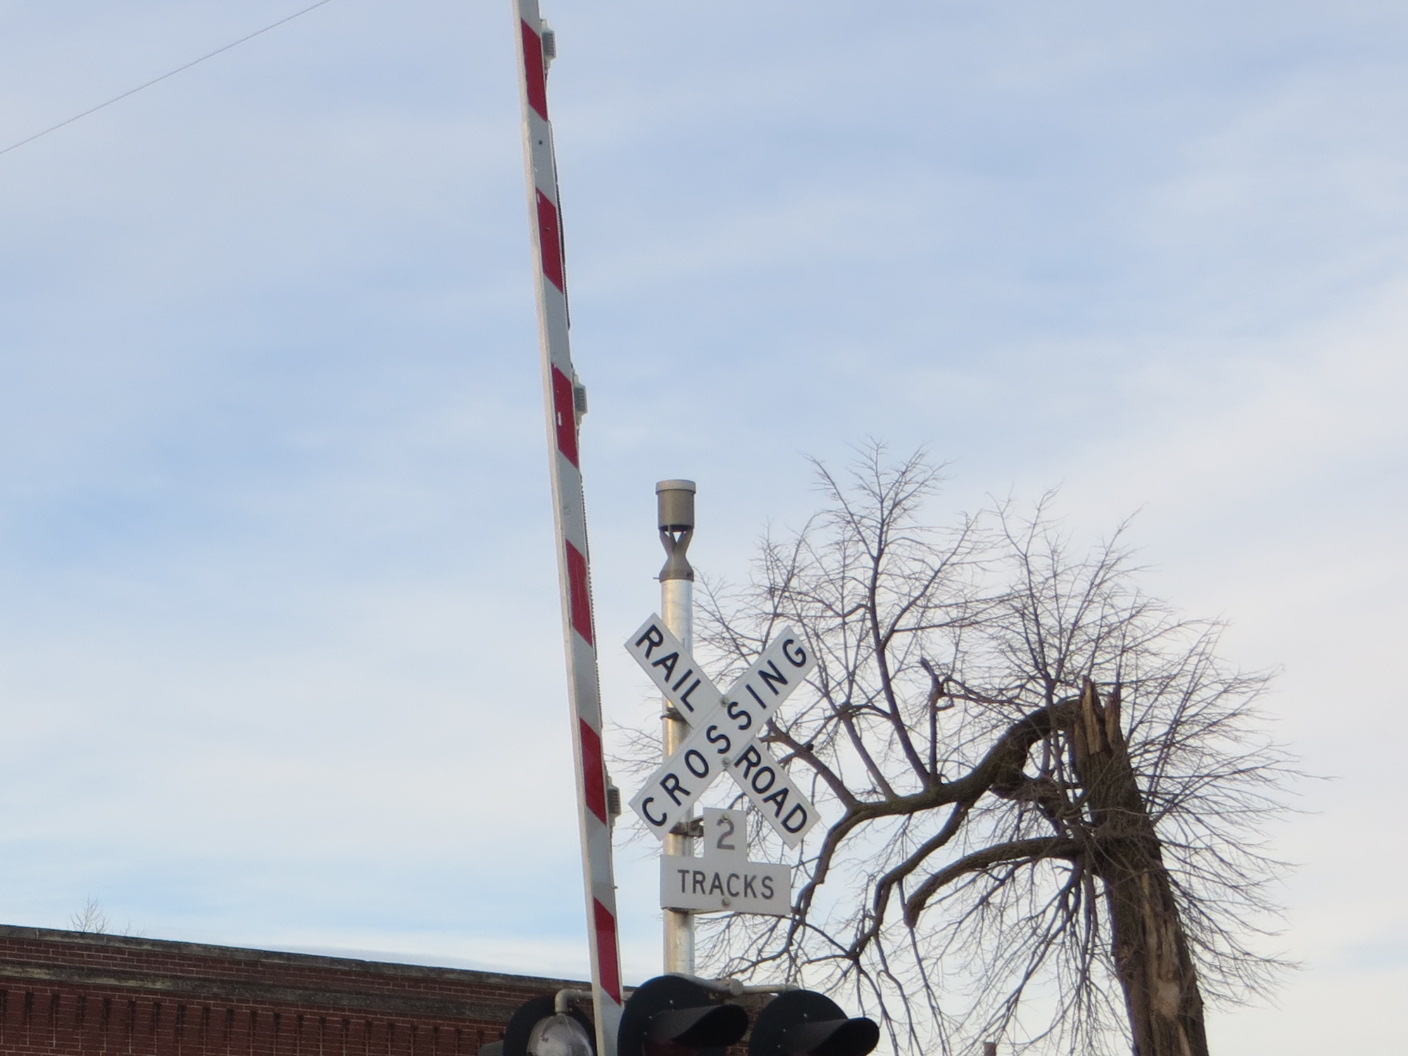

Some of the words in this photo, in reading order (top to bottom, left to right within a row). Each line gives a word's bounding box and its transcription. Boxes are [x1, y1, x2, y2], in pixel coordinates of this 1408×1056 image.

[635, 623, 702, 713] RAIL
[734, 744, 808, 835] ROAD
[641, 637, 807, 829] CROSSING
[677, 869, 774, 900] TRACKS
[715, 817, 736, 850] 2
